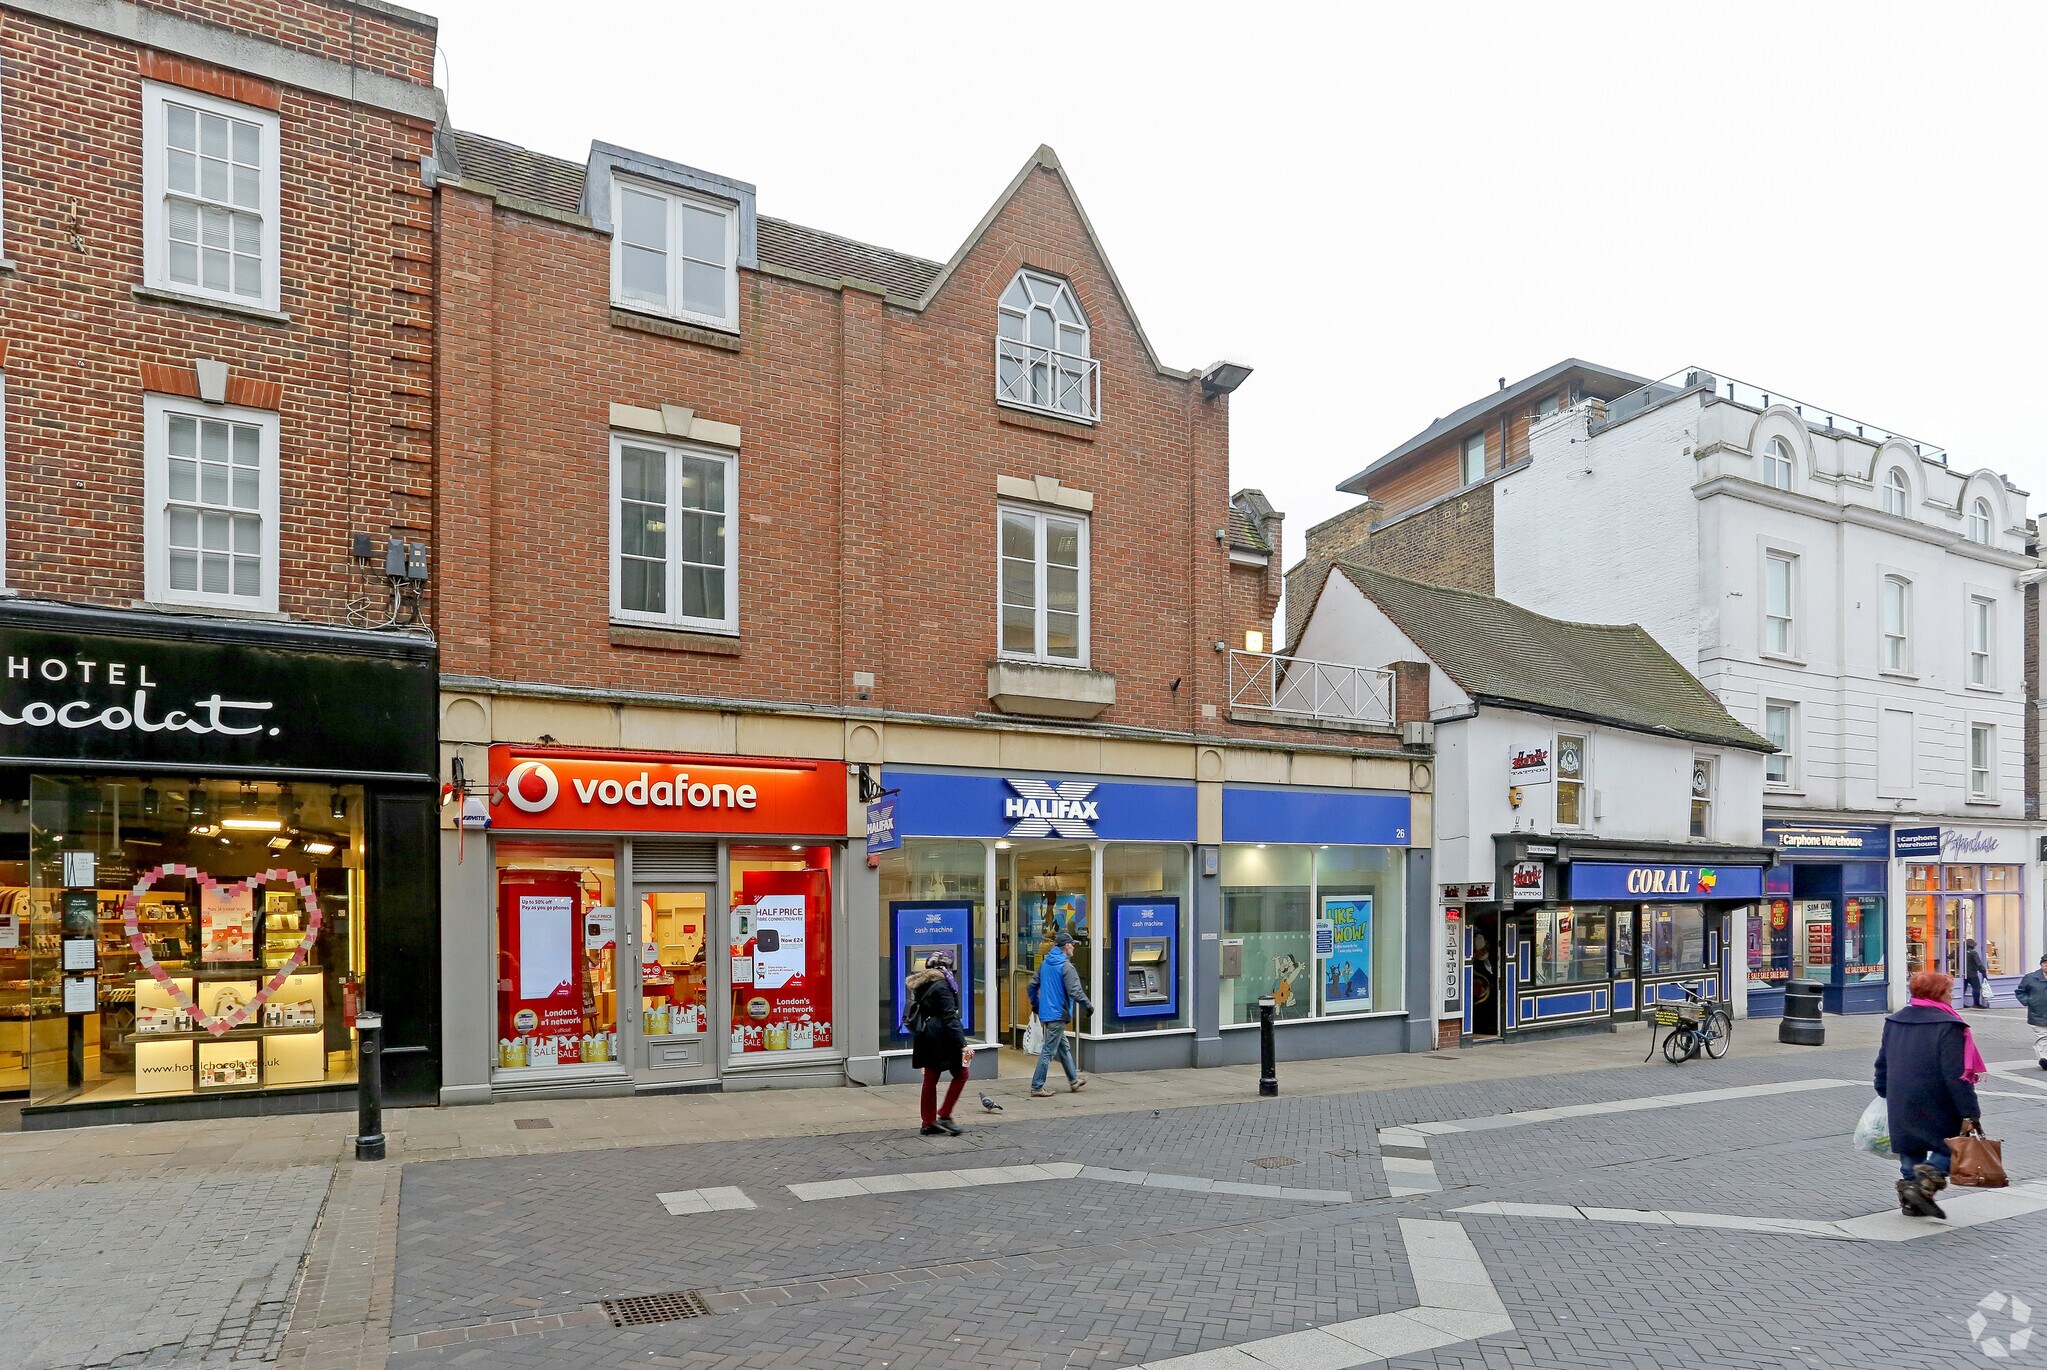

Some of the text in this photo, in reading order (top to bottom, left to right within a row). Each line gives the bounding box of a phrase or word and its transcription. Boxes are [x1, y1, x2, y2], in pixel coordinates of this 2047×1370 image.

[8, 656, 157, 687] HOTEL
[0, 690, 280, 735] ocolat.
[1511, 767, 1548, 776] TATTOO
[573, 772, 757, 808] vodafone
[1005, 798, 1100, 820] HALIFAX
[866, 818, 894, 834] HALIFAX
[1396, 828, 1405, 838] 26
[1900, 834, 1938, 842] Carphone
[1784, 834, 1821, 848] Carphone
[1821, 835, 1863, 847] Warehouse
[1628, 868, 1691, 894] CORAL
[1328, 907, 1357, 924] LIKE,
[1847, 915, 1857, 923] SALE
[1774, 917, 1784, 925] SALE
[1334, 922, 1367, 942] WOW!
[1446, 924, 1458, 998] TATTOO
[544, 1008, 578, 1017] London's
[550, 1017, 581, 1025] network
[676, 1015, 696, 1025] SALE
[732, 1035, 742, 1043] LE
[793, 1032, 811, 1040] SALE
[506, 1052, 525, 1061] SALE
[534, 1047, 556, 1057] SALE
[142, 1058, 280, 1074] www.hotlchocolat.co.uk
